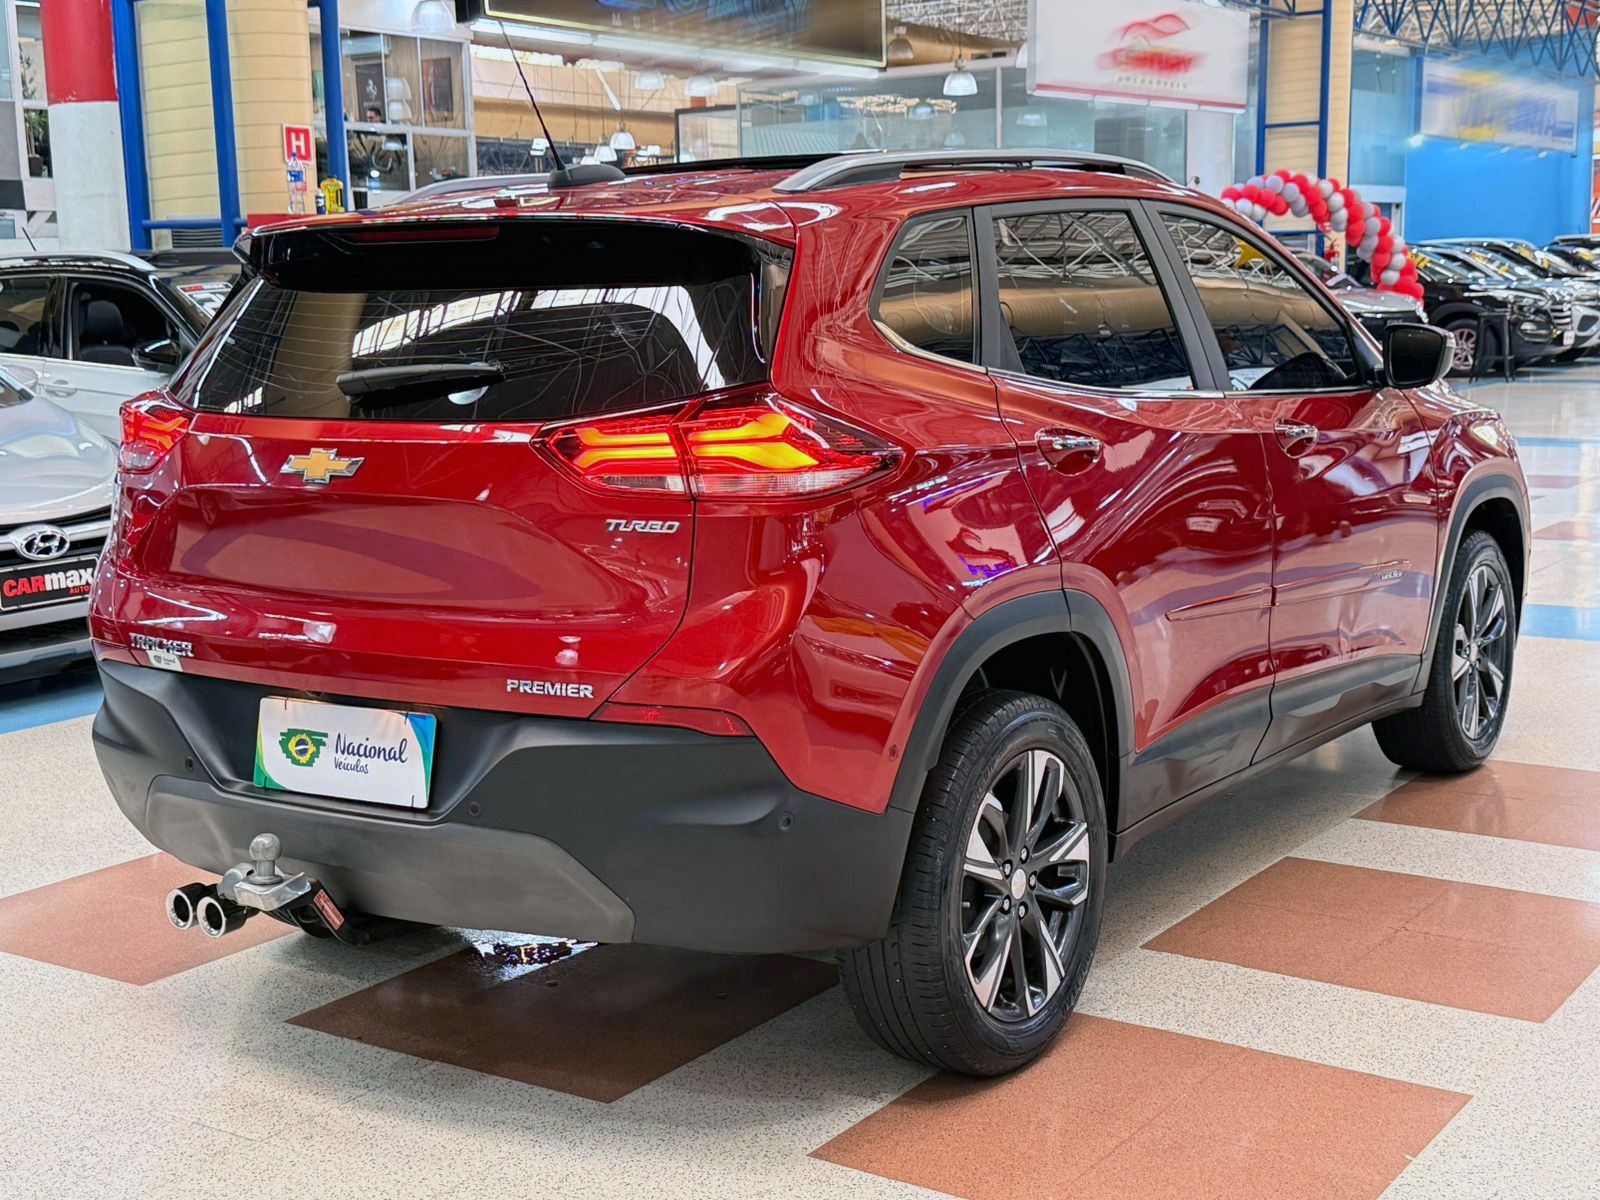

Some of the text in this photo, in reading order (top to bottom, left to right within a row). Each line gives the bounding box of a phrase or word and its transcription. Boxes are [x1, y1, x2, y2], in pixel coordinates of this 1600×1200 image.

[291, 132, 306, 156] H
[606, 519, 680, 533] TURBO
[69, 585, 92, 594] AUTO
[506, 678, 594, 699] PREMIER
[335, 732, 408, 763] Nacional
[334, 756, 369, 774] Veículos
